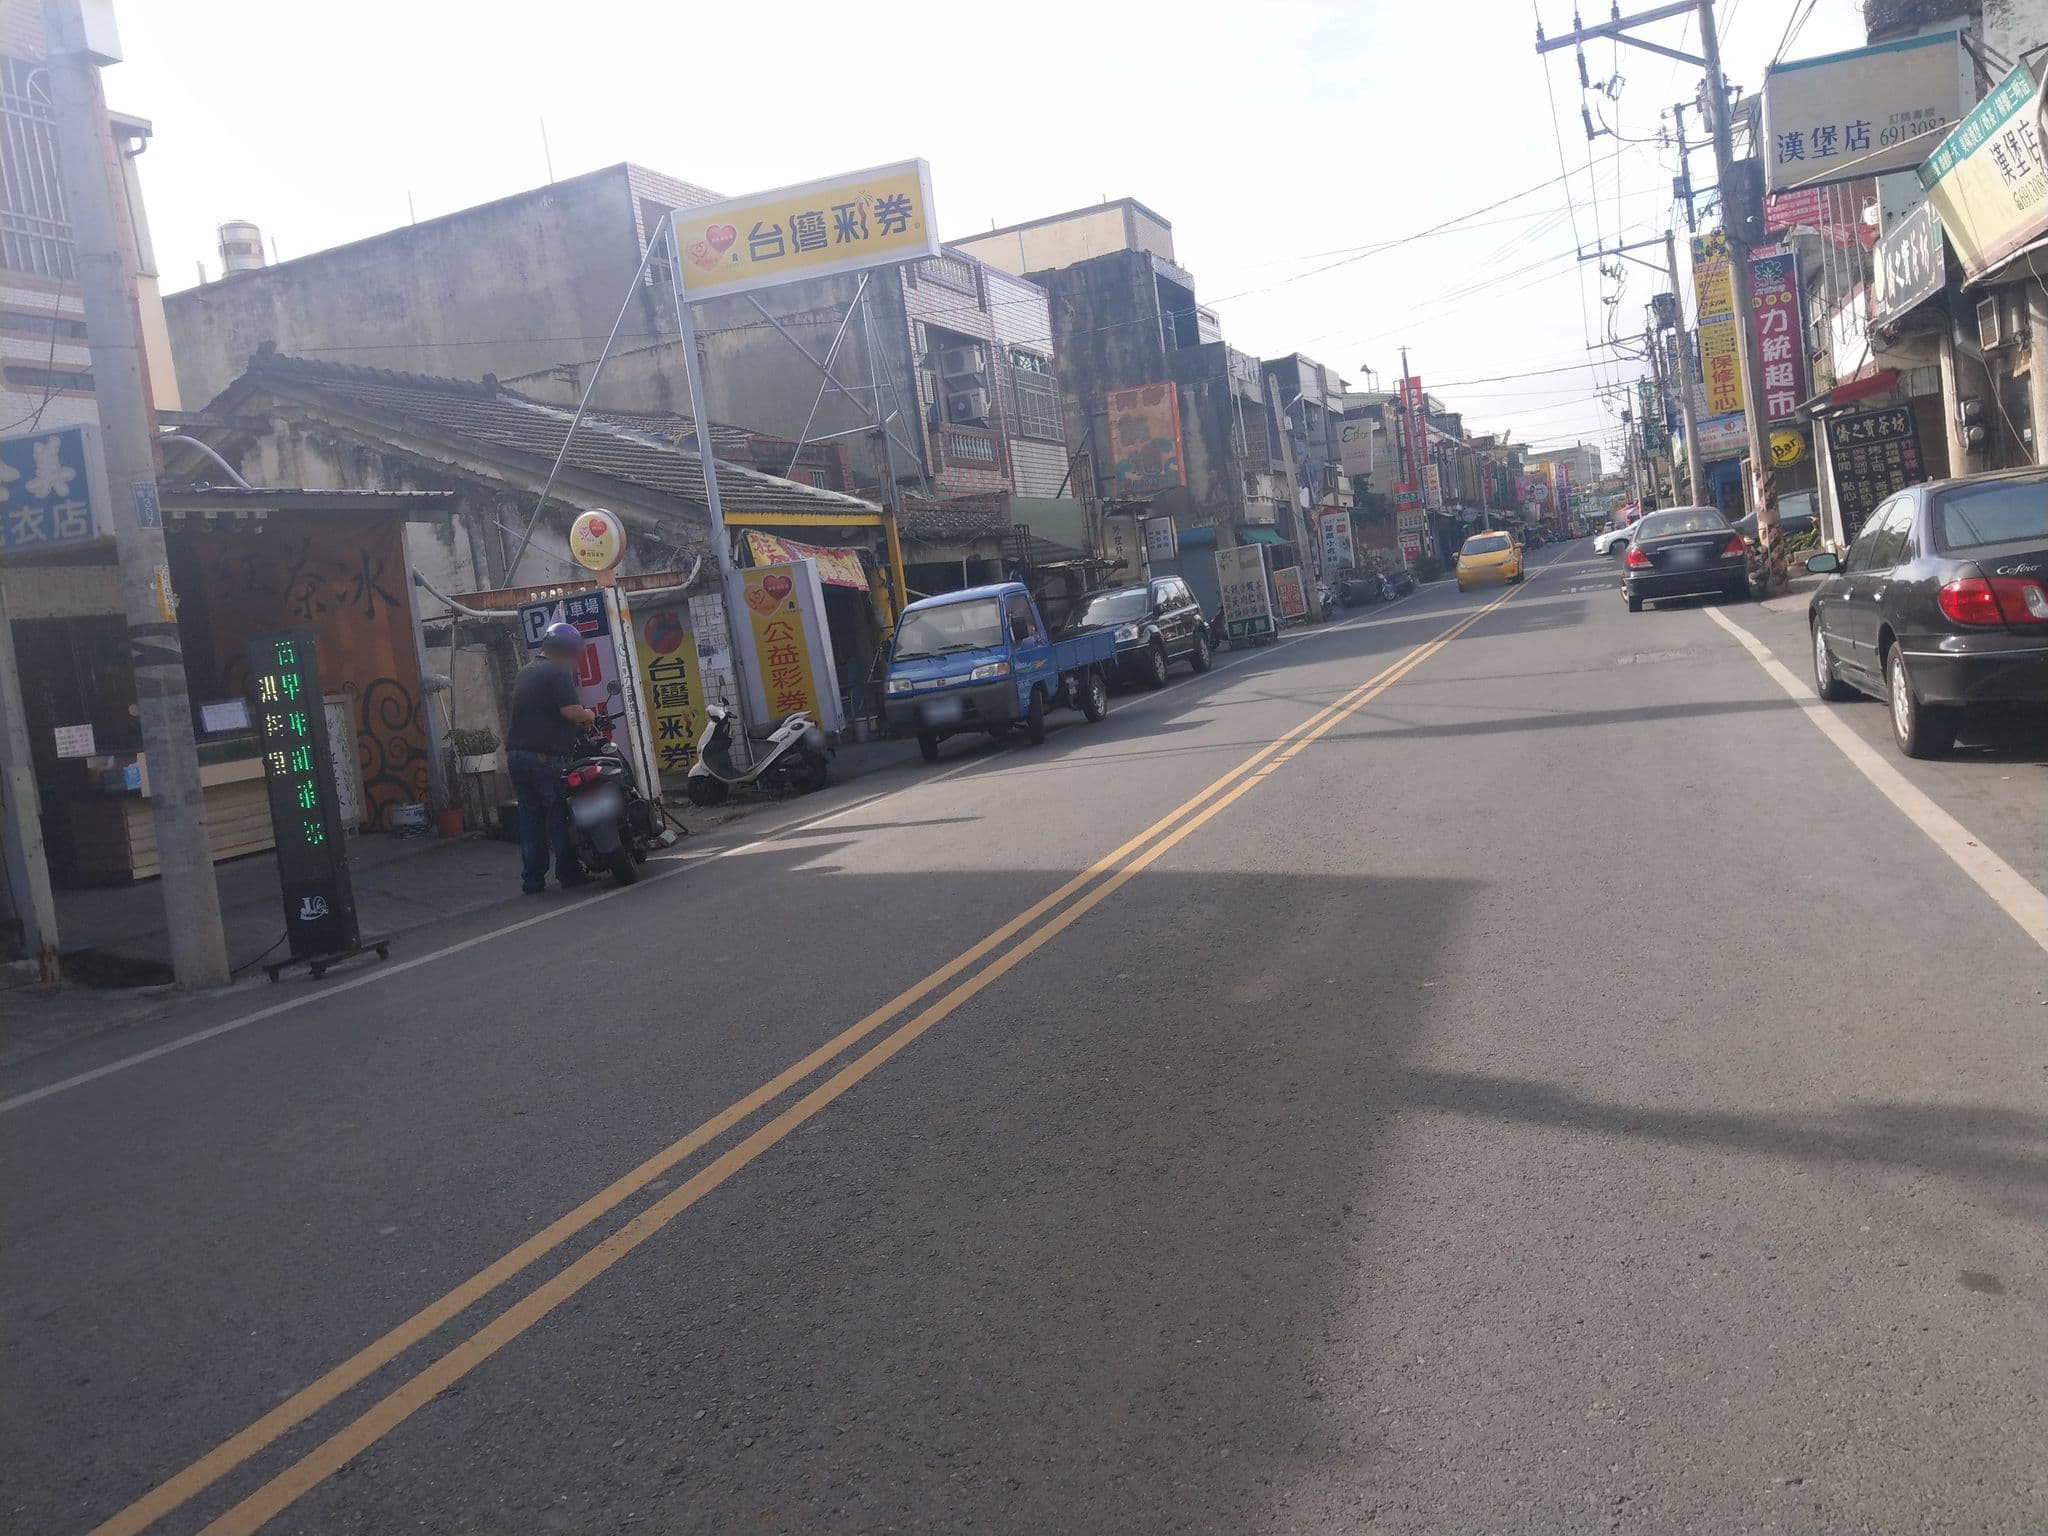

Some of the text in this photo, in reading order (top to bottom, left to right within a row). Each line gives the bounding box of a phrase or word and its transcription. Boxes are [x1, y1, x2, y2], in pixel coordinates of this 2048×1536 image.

[1777, 120, 1872, 164] 漢堡店
[1880, 118, 1946, 146] 6913083
[1990, 119, 2042, 187] 漢堡店
[747, 191, 913, 262] 台灣彩券
[1710, 354, 1738, 411] 保修中心
[1759, 308, 1796, 417] 力統超市
[1772, 438, 1797, 458] Bar
[0, 500, 88, 546] 衣店
[1997, 563, 2041, 575] Cefiro
[530, 612, 545, 638] P
[763, 621, 808, 713] 公益彩券
[648, 656, 698, 768] 台灣彩券
